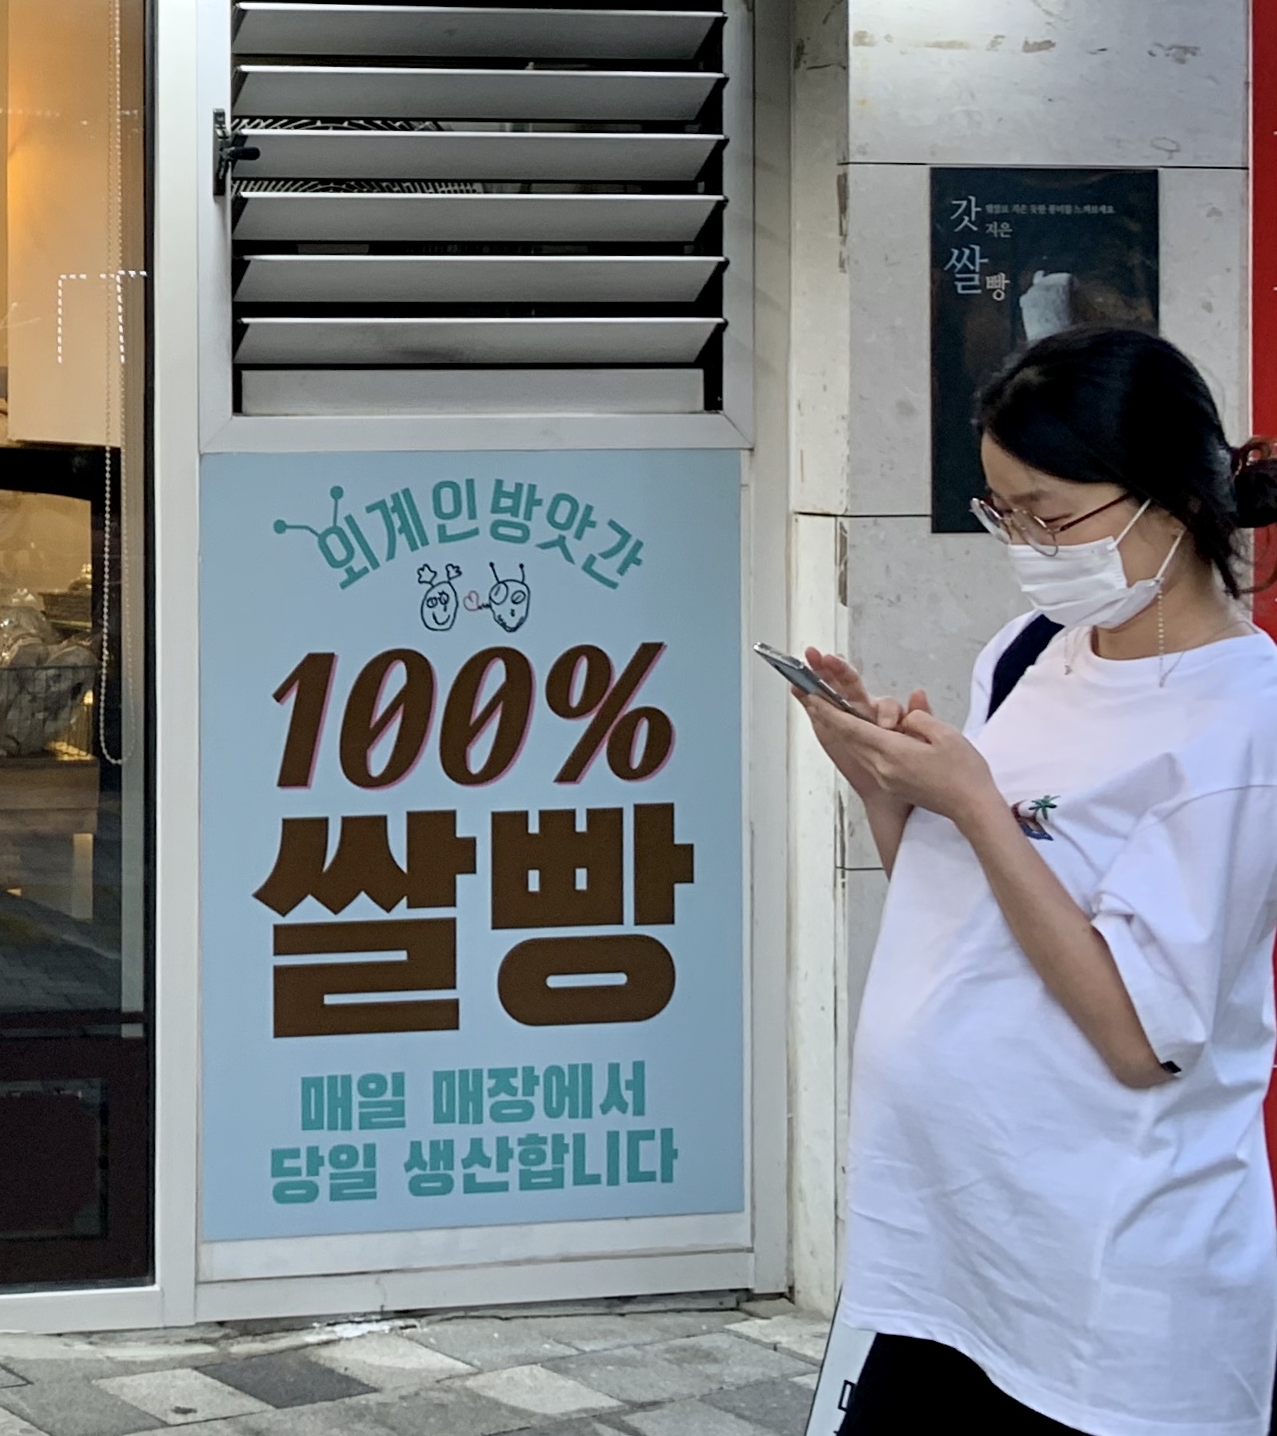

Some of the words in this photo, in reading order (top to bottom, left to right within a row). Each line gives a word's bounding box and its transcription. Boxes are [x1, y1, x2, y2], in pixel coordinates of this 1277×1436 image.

[950, 196, 982, 232] 갓
[984, 221, 1013, 238] 지은
[943, 244, 989, 295] 쌀
[985, 271, 1011, 302] 빵
[318, 477, 644, 591] 외계인방앗간
[271, 641, 676, 789] 100%
[252, 802, 695, 1039] 쌀빵
[300, 1071, 407, 1132] 매일
[432, 1060, 647, 1127] 매장에서
[270, 1143, 379, 1205] 당일
[403, 1127, 679, 1199] 생산합니다
